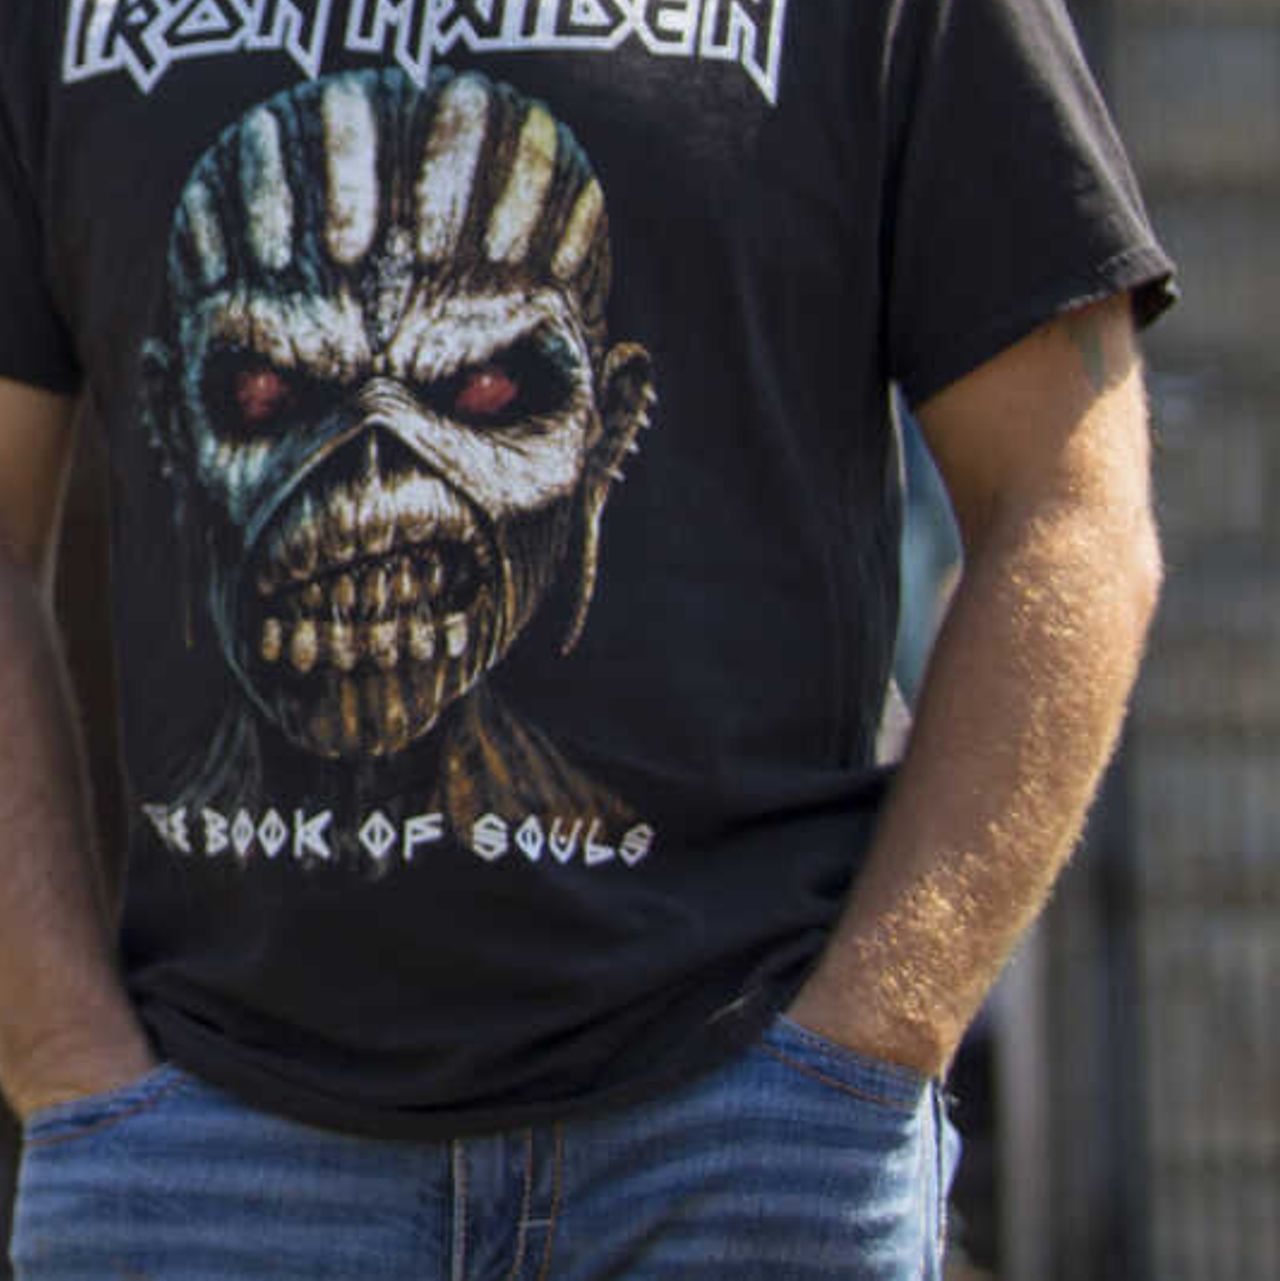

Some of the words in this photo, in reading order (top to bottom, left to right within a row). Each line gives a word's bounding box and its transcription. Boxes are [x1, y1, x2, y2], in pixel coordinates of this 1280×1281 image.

[201, 806, 335, 860] BOOK
[357, 809, 444, 862] OF
[471, 811, 655, 866] SOULS
